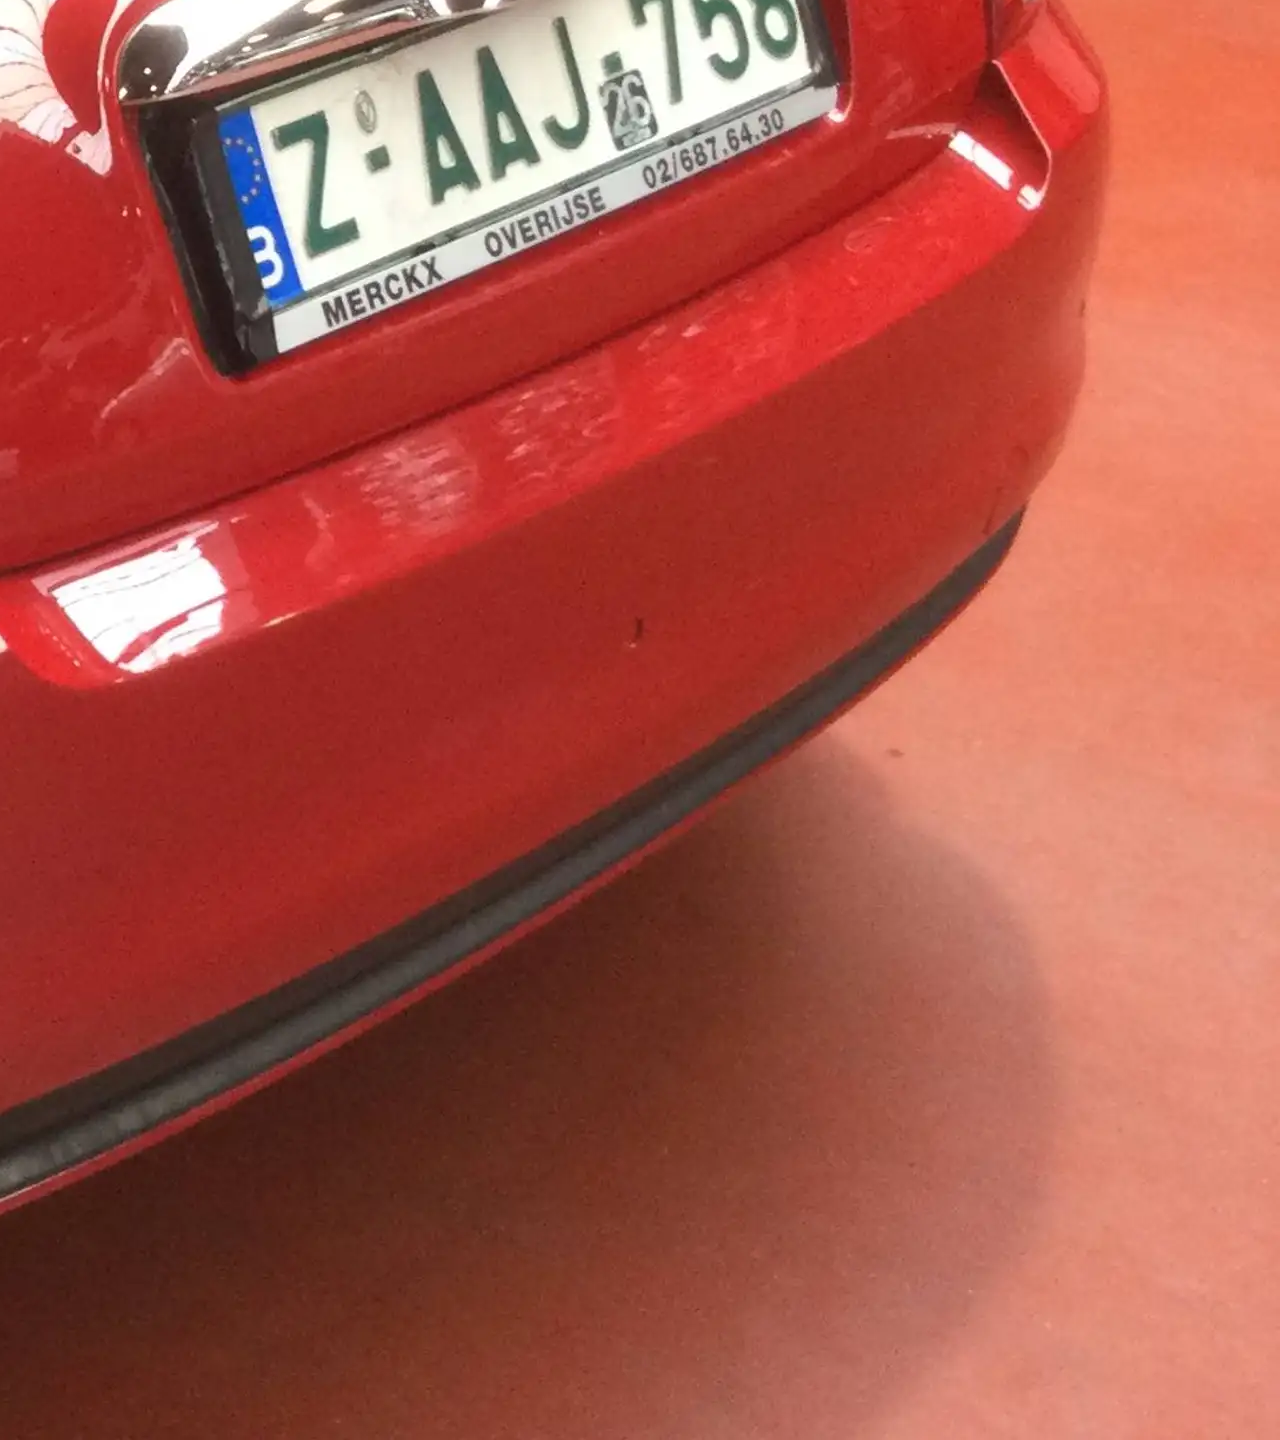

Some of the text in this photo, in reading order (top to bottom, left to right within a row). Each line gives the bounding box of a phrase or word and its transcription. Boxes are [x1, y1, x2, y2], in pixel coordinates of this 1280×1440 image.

[321, 107, 786, 329] MERCKX OVERIJSE 02/687.64.30
